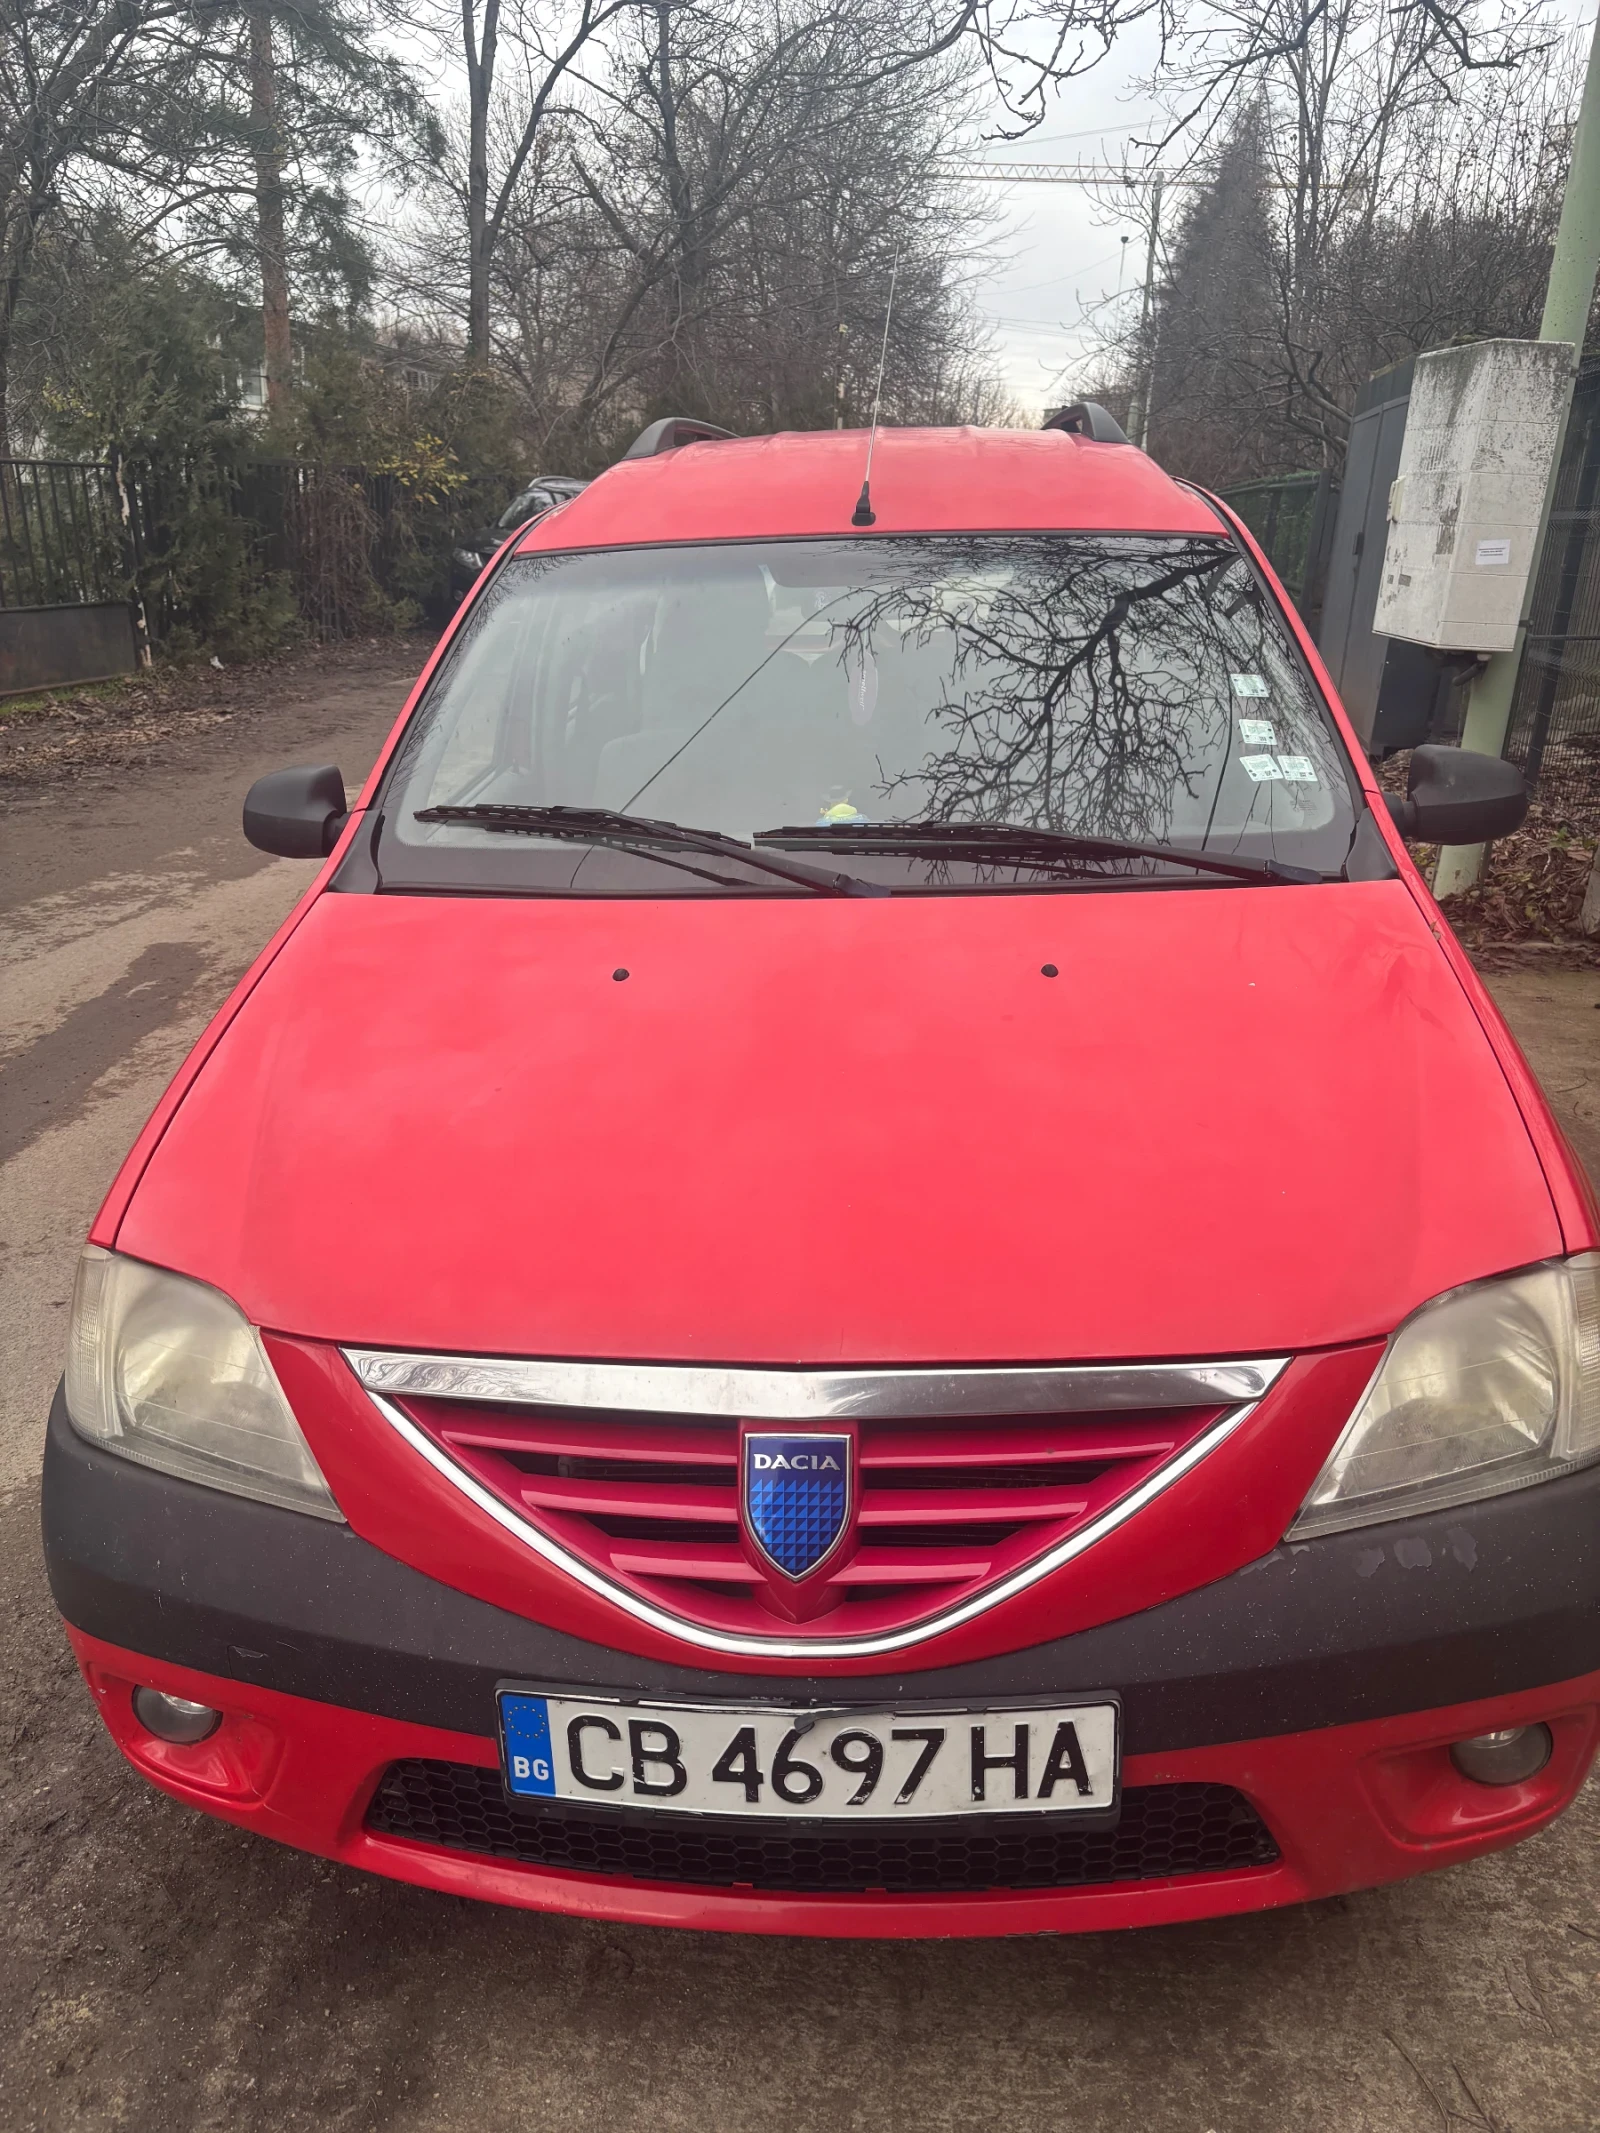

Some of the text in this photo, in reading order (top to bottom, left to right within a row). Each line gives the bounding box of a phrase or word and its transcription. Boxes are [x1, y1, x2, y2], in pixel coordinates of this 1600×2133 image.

[753, 1453, 841, 1471] DACIA
[513, 1755, 549, 1781] BG
[566, 1714, 1094, 1806] CB 4697 HA
